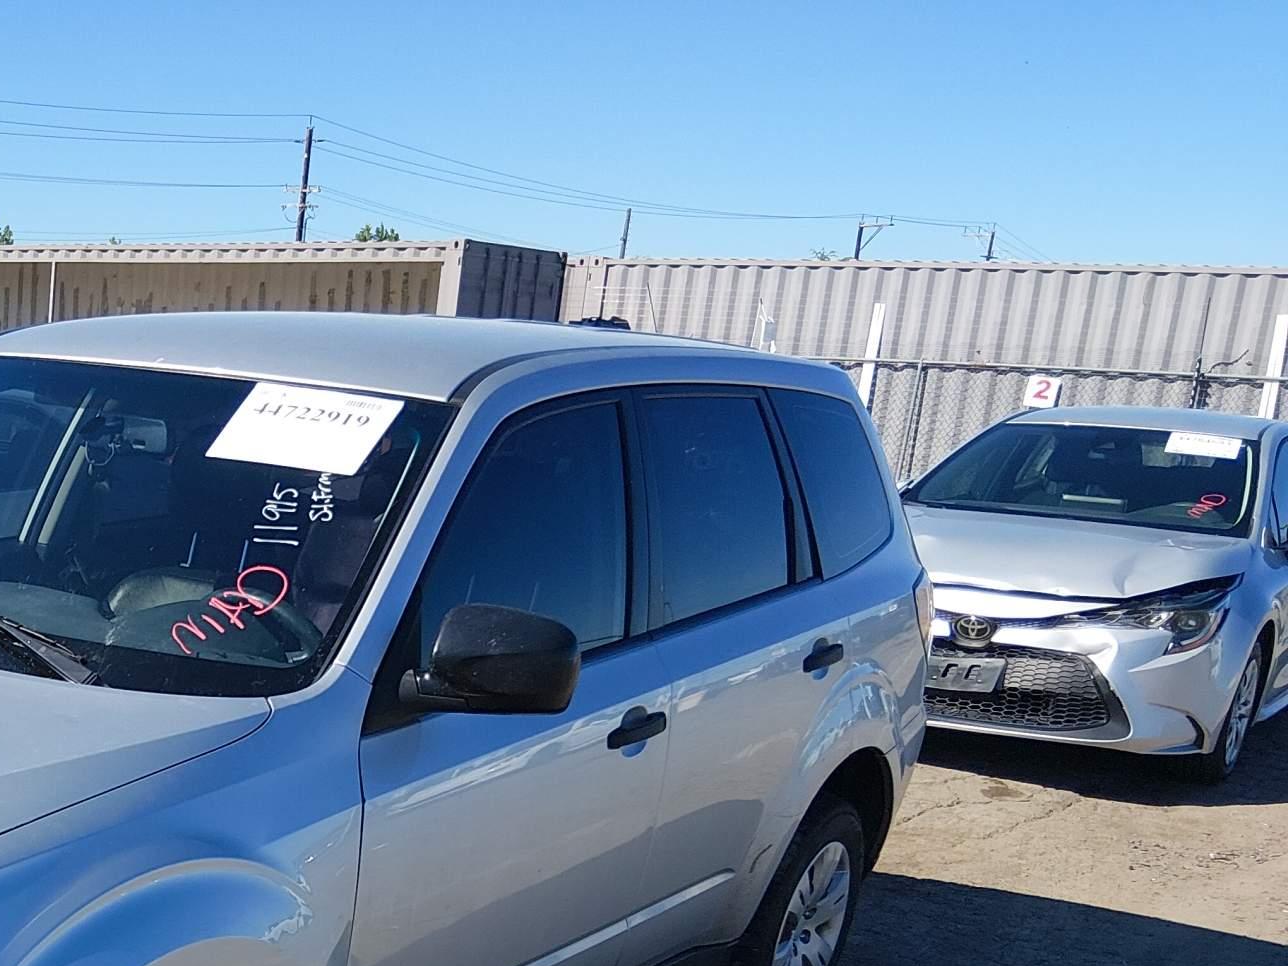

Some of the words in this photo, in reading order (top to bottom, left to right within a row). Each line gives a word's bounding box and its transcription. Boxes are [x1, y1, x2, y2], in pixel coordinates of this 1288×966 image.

[1032, 379, 1052, 400] 2
[253, 401, 371, 428] 44722919
[253, 482, 299, 546] 11915
